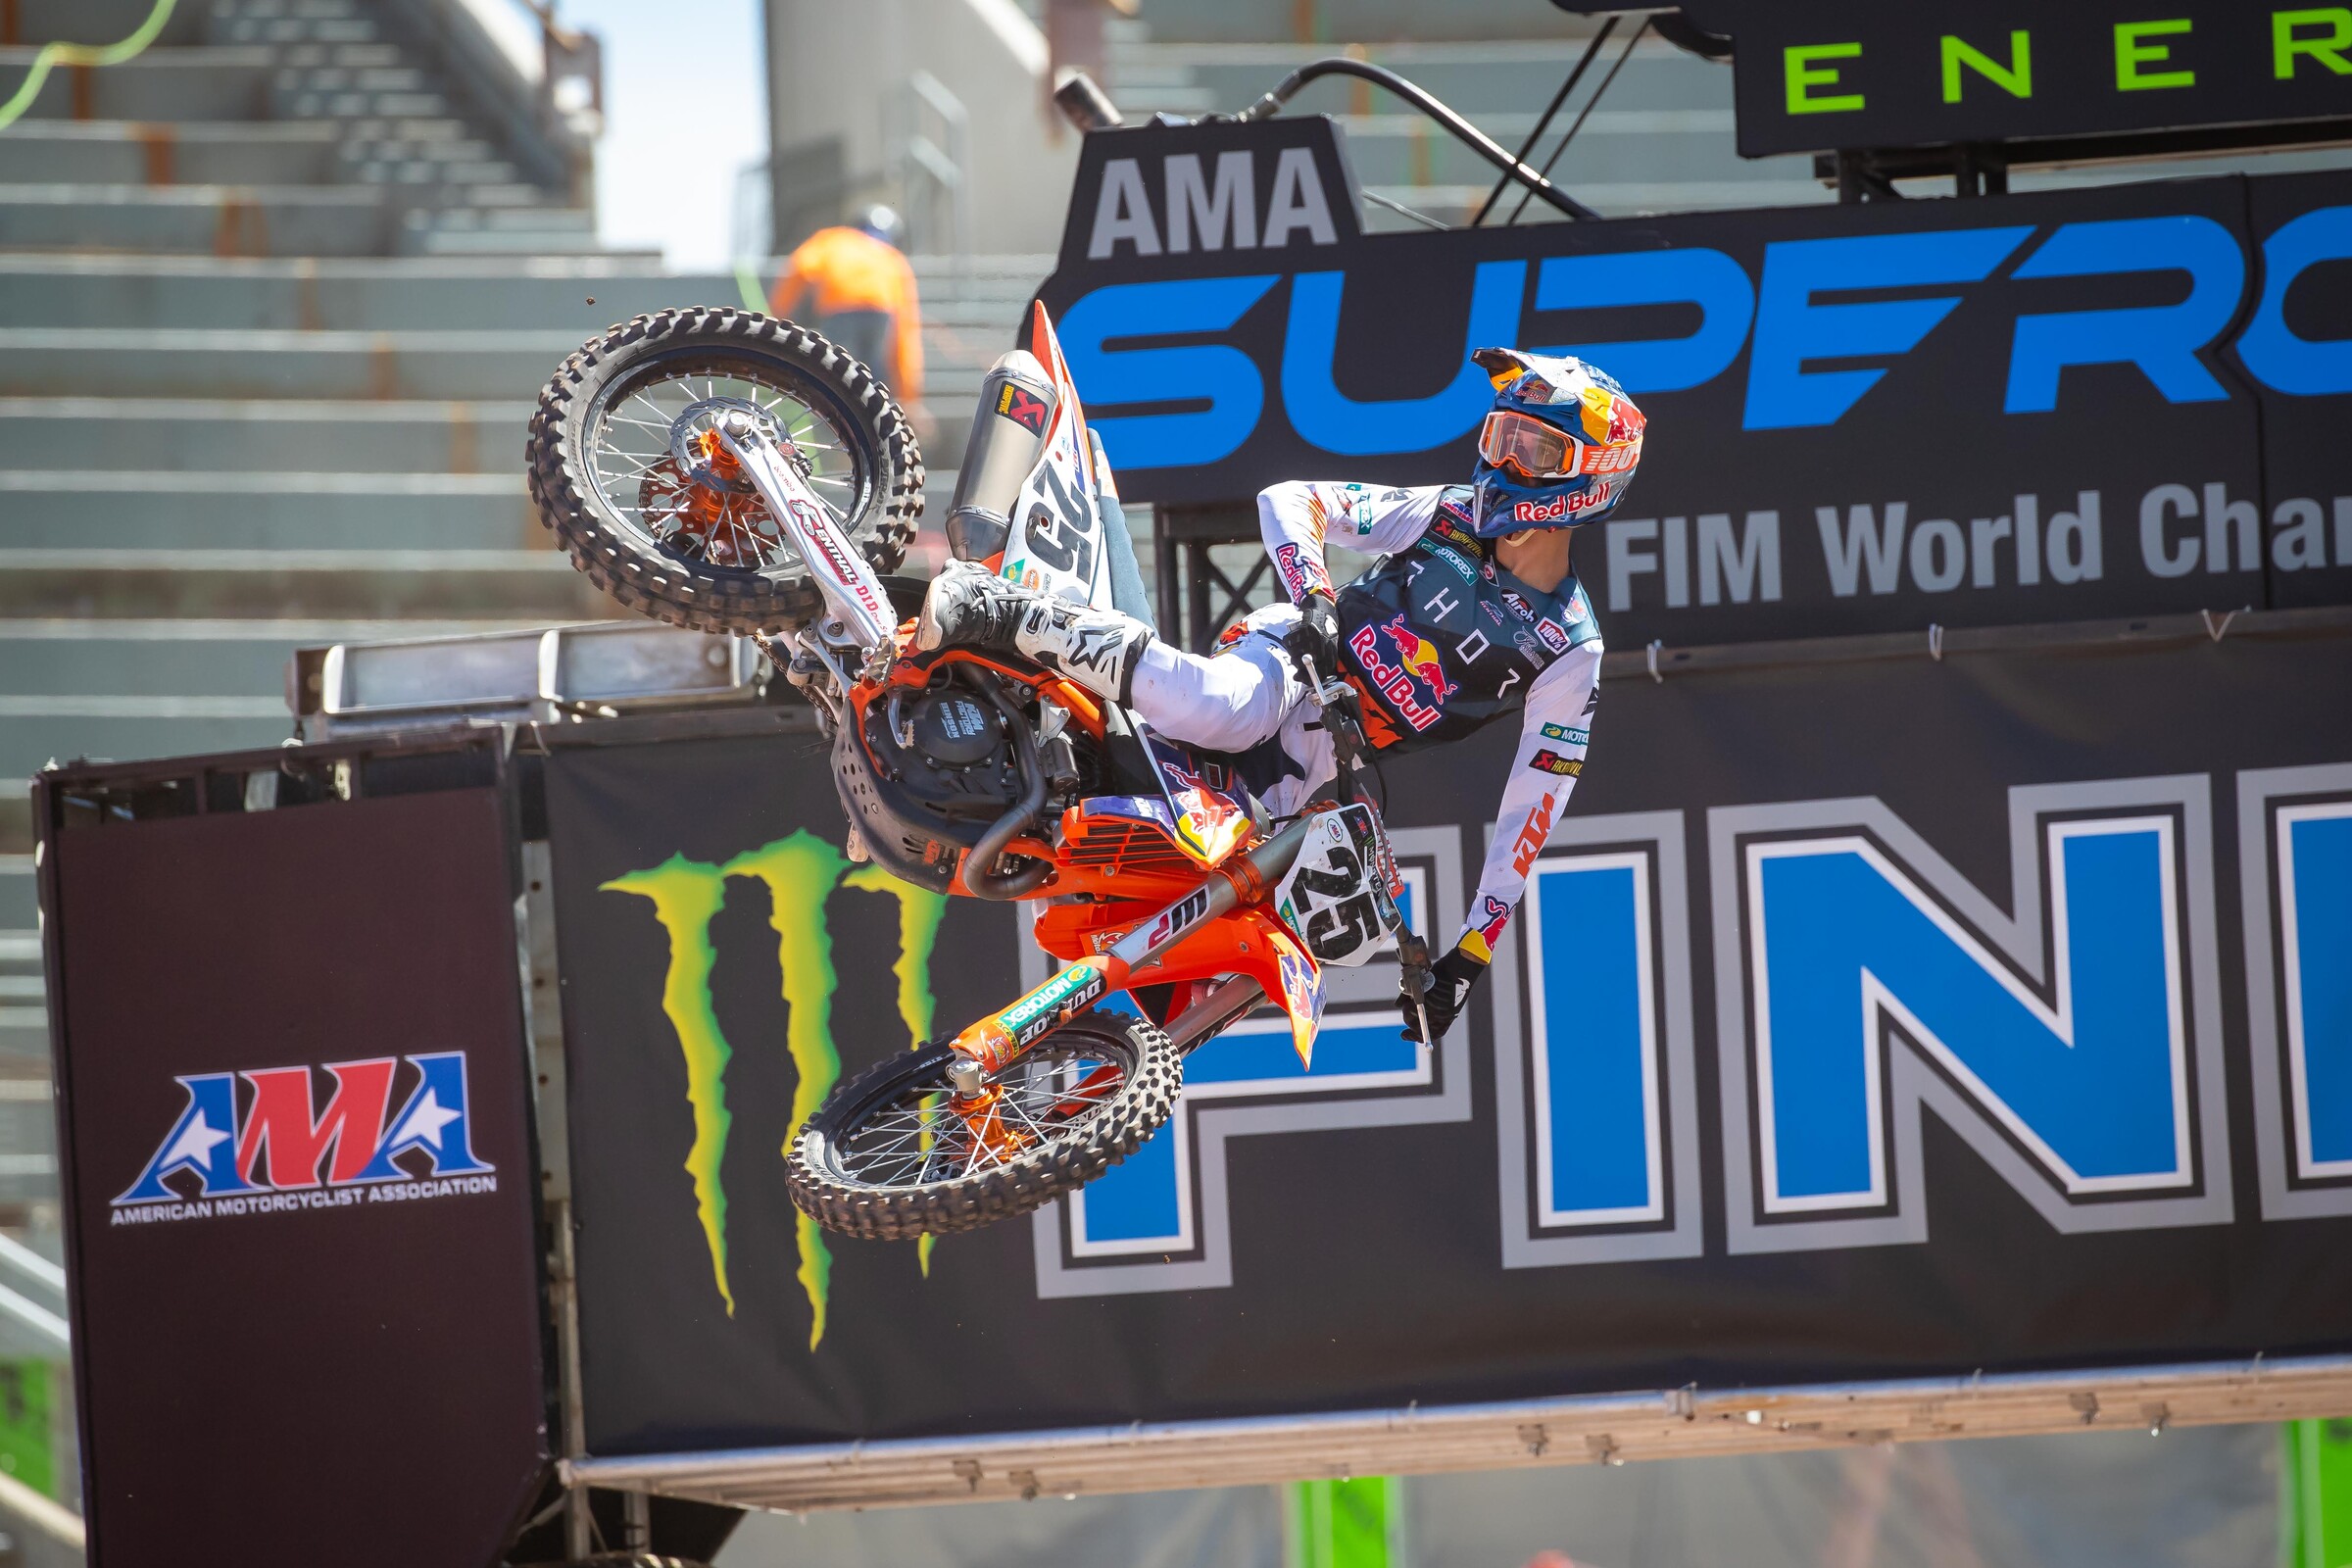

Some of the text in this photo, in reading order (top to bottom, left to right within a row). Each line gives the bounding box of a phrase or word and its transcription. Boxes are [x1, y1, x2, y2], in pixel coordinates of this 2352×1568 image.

[1089, 148, 1337, 260] AMA
[1528, 391, 1546, 403] Bull
[1024, 458, 1093, 585] 25
[1514, 481, 1610, 521] Red Bull
[789, 499, 859, 586] RENTHAL
[1278, 545, 1302, 581] Red
[1606, 511, 1783, 612] FIM
[1814, 490, 2104, 600] World
[1480, 601, 1501, 627] RENTHAL
[1502, 594, 1535, 623] Airoh
[1539, 624, 1566, 649] 100%
[1349, 624, 1443, 732] Red Bull
[940, 701, 961, 739] HINSON
[955, 700, 977, 736] FACTORY
[964, 702, 985, 731] KTM
[1512, 792, 1556, 881] KTM
[1147, 887, 1208, 951] WP
[1290, 846, 1382, 961] 25
[1003, 977, 1073, 1026] MOTOREX
[1019, 979, 1102, 1047] DUNOP
[110, 1051, 496, 1206] AMA
[110, 1176, 497, 1226] AMERICAN MOTORCYCLIST ASSOCIATION
